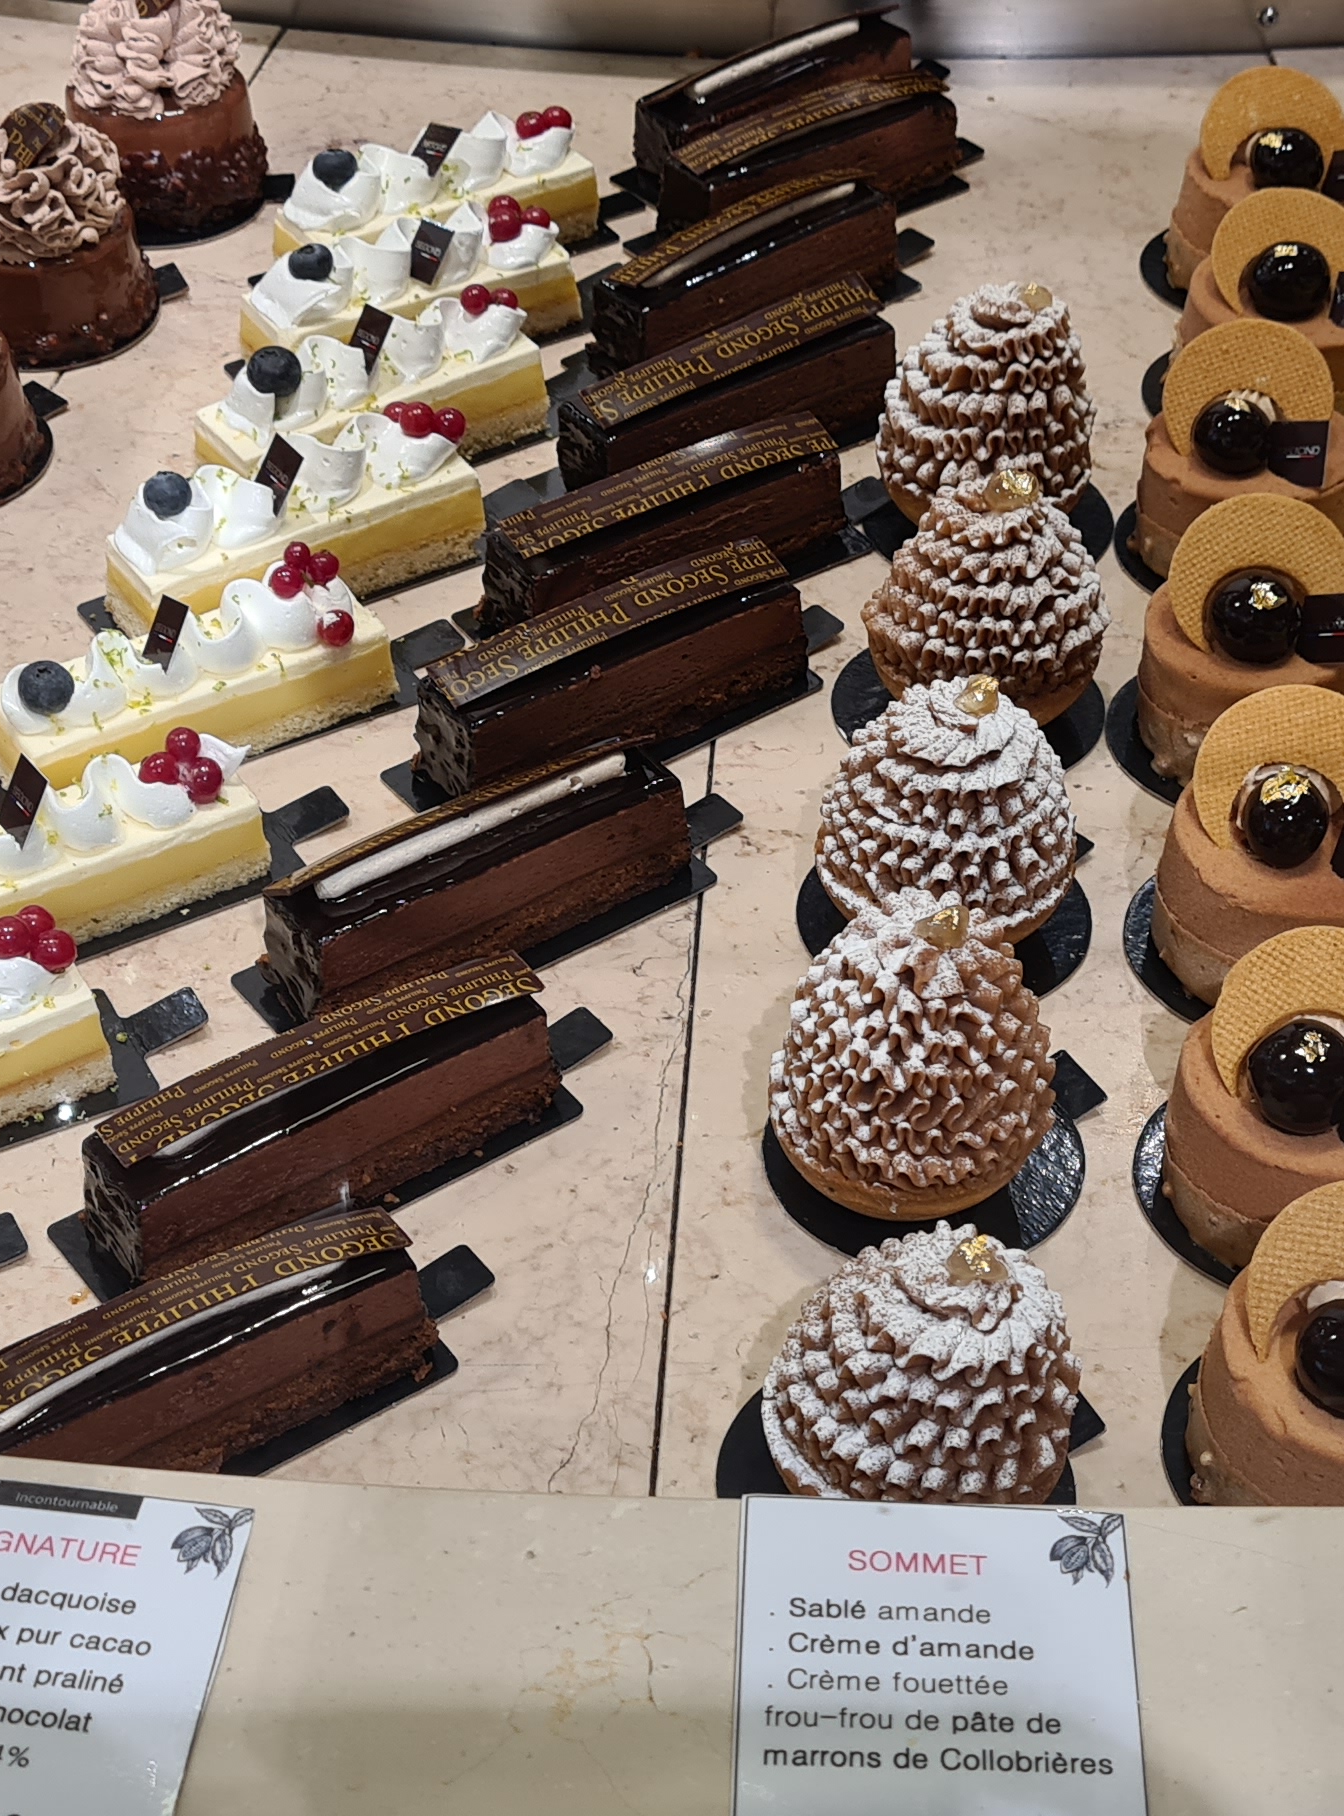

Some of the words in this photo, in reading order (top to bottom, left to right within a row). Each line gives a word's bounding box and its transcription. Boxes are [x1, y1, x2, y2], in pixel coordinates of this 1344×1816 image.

[714, 313, 800, 361] SEGOND
[615, 351, 715, 407] PHILIPPE
[718, 441, 804, 481] SEGOND
[631, 561, 729, 610] SEGOND
[516, 599, 631, 662] PHILIPPE
[445, 967, 512, 998] PHILIPPE
[384, 990, 448, 1023] SEGOND
[422, 973, 536, 1029] SEGOND
[113, 1083, 186, 1127] PHILIPPE
[181, 1075, 255, 1119] PHILIPPE
[115, 1111, 184, 1155] SEGOND
[302, 1222, 377, 1249] PHILIPPE
[232, 1242, 302, 1276] SEGOND
[1, 1340, 82, 1391] PHILIPPE
[15, 1490, 119, 1514] Incontournable
[847, 1549, 988, 1576] SOMMET
[0, 1581, 137, 1616] dacquoise
[788, 1597, 867, 1620] Sablé
[877, 1603, 992, 1625] amande
[15, 1627, 62, 1647] pur
[69, 1631, 152, 1657] cacao
[788, 1632, 881, 1656] Crème
[892, 1634, 1035, 1662] d'amande
[33, 1667, 124, 1696] praliné
[787, 1667, 881, 1692] Crème
[892, 1671, 1009, 1697] fouettée
[905, 1709, 940, 1733] de
[951, 1710, 1015, 1736] pâte
[1027, 1713, 1062, 1736] de
[763, 1747, 882, 1770] marrons
[893, 1747, 929, 1771] de
[940, 1746, 1114, 1775] Collobrières
